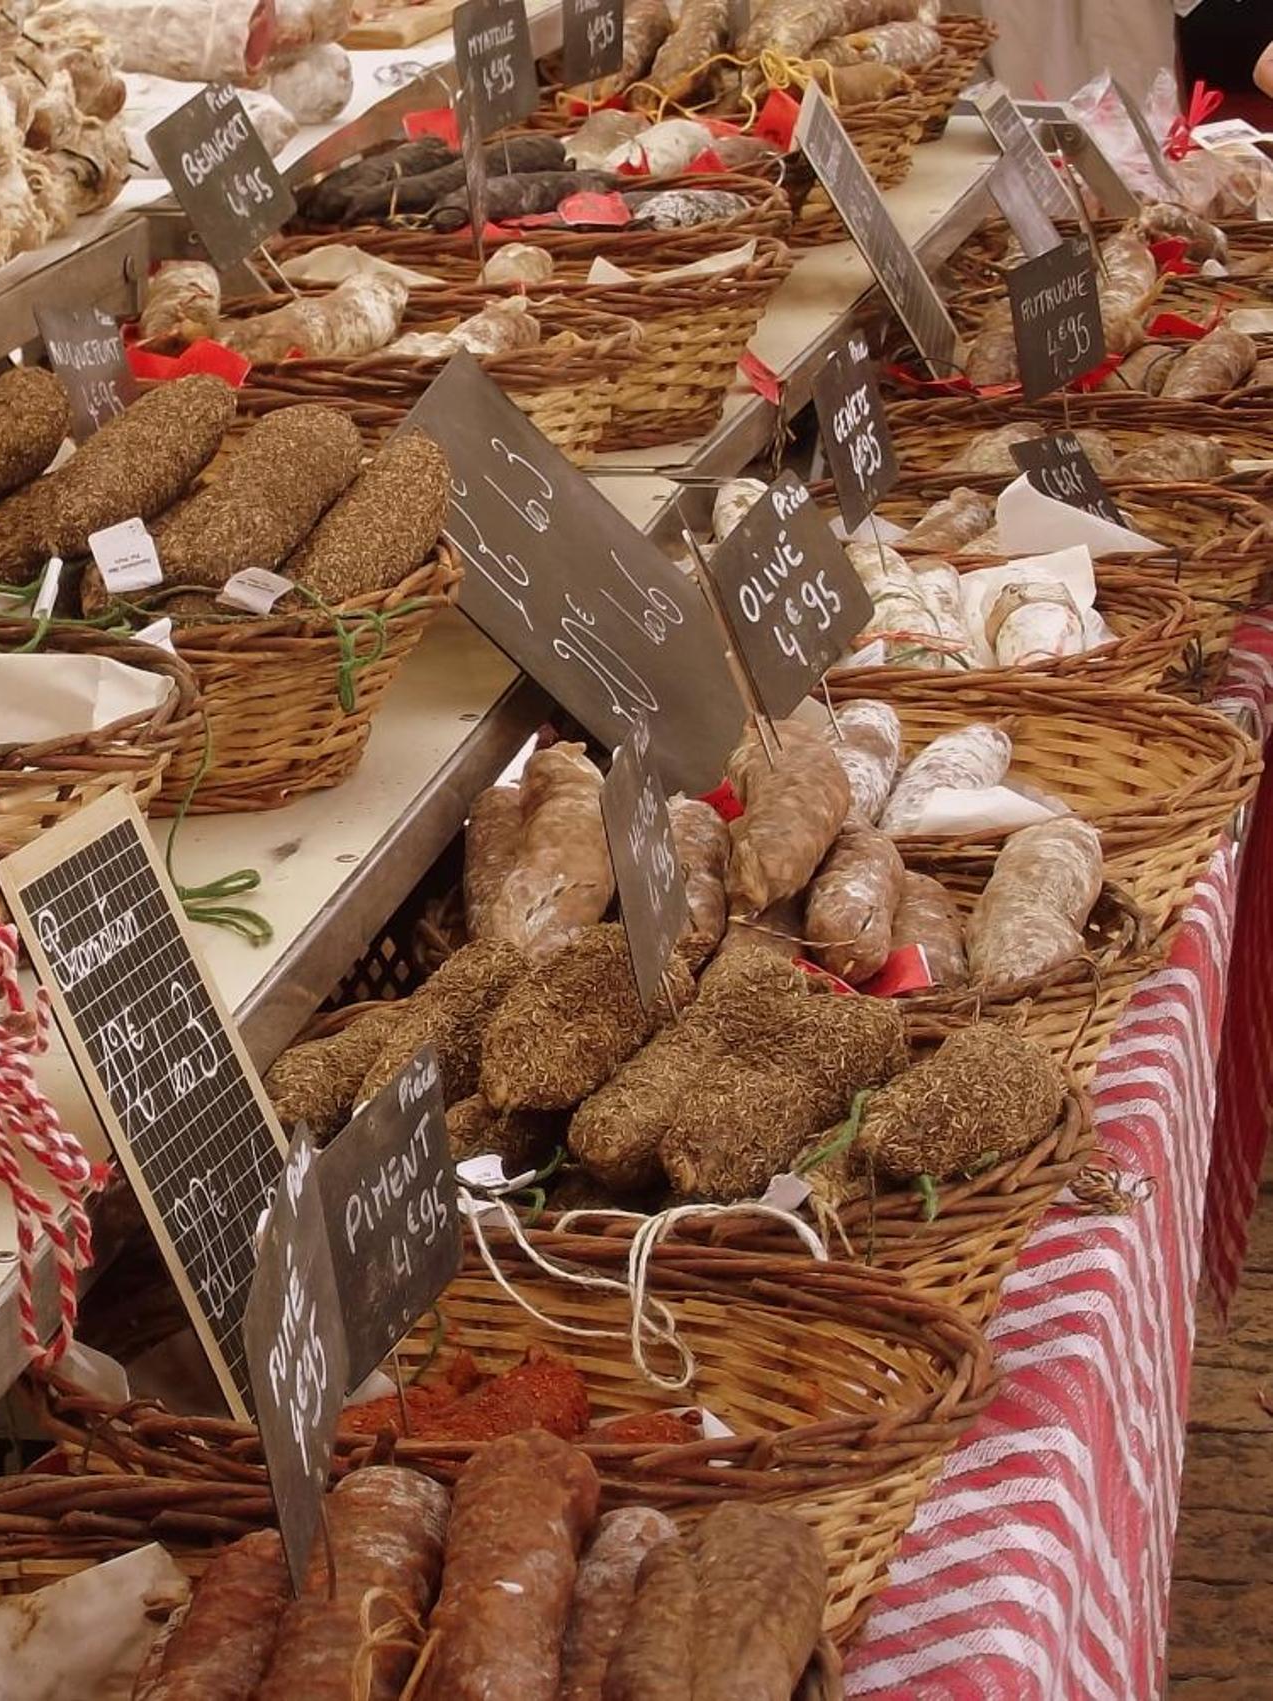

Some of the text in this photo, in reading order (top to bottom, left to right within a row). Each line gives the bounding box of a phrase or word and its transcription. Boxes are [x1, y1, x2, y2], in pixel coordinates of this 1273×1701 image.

[181, 112, 249, 187] BEAUFORT
[1021, 269, 1090, 322] AUTRUCHE
[1047, 312, 1091, 376] 4€95
[491, 438, 553, 499] 3
[848, 420, 882, 492] 4€95
[1042, 462, 1087, 500] CERF
[610, 550, 683, 624] 6
[774, 569, 842, 667] 4€95
[38, 874, 139, 991] Promotion
[171, 981, 218, 1078] 3
[174, 1168, 235, 1320] 20€
[390, 1168, 448, 1277] 4€95
[290, 1301, 327, 1477] 4€95
